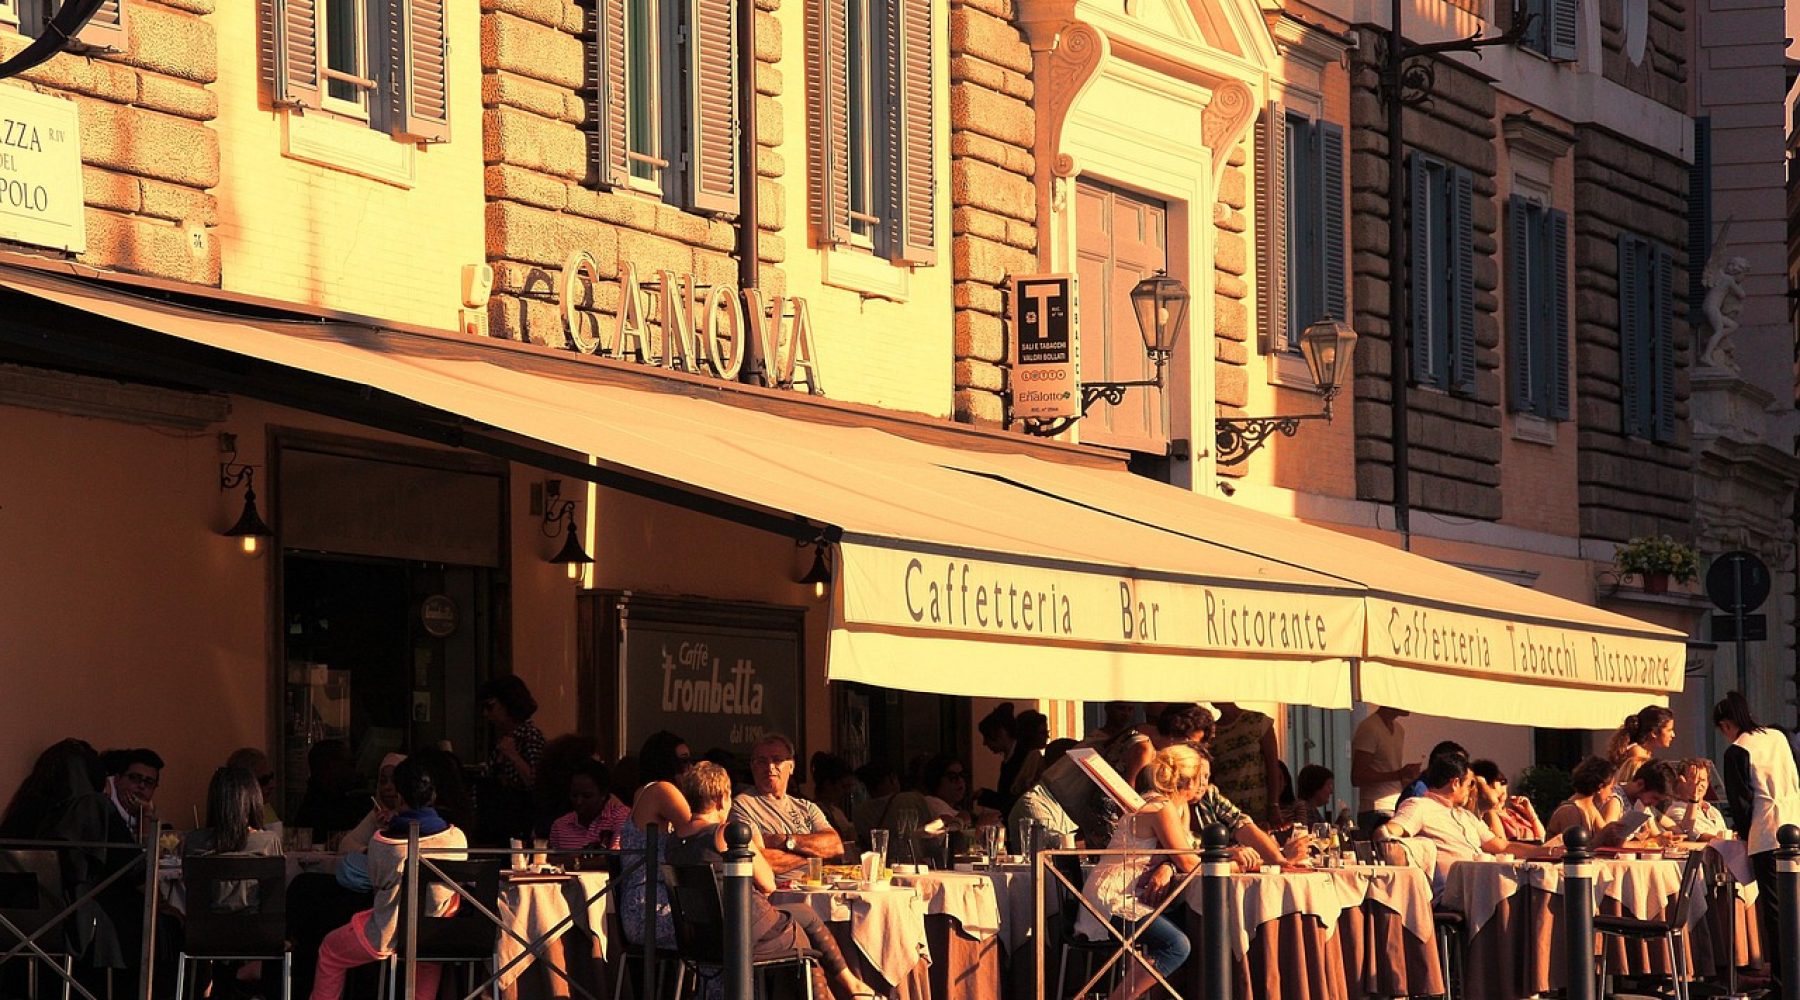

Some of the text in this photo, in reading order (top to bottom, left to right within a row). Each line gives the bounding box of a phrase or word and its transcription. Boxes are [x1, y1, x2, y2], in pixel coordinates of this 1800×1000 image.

[0, 119, 42, 152] ZZA
[560, 251, 825, 395] CANOVA
[1025, 284, 1060, 338] T
[1023, 353, 1042, 361] VALORI
[1039, 341, 1066, 350] TABACCHI
[904, 558, 1327, 651] Caffetteria Bar Ristorante
[679, 641, 708, 671] Caffè
[1387, 606, 1670, 686] Caffetteria Tabacchi Ristorante
[662, 653, 764, 714] trombetta
